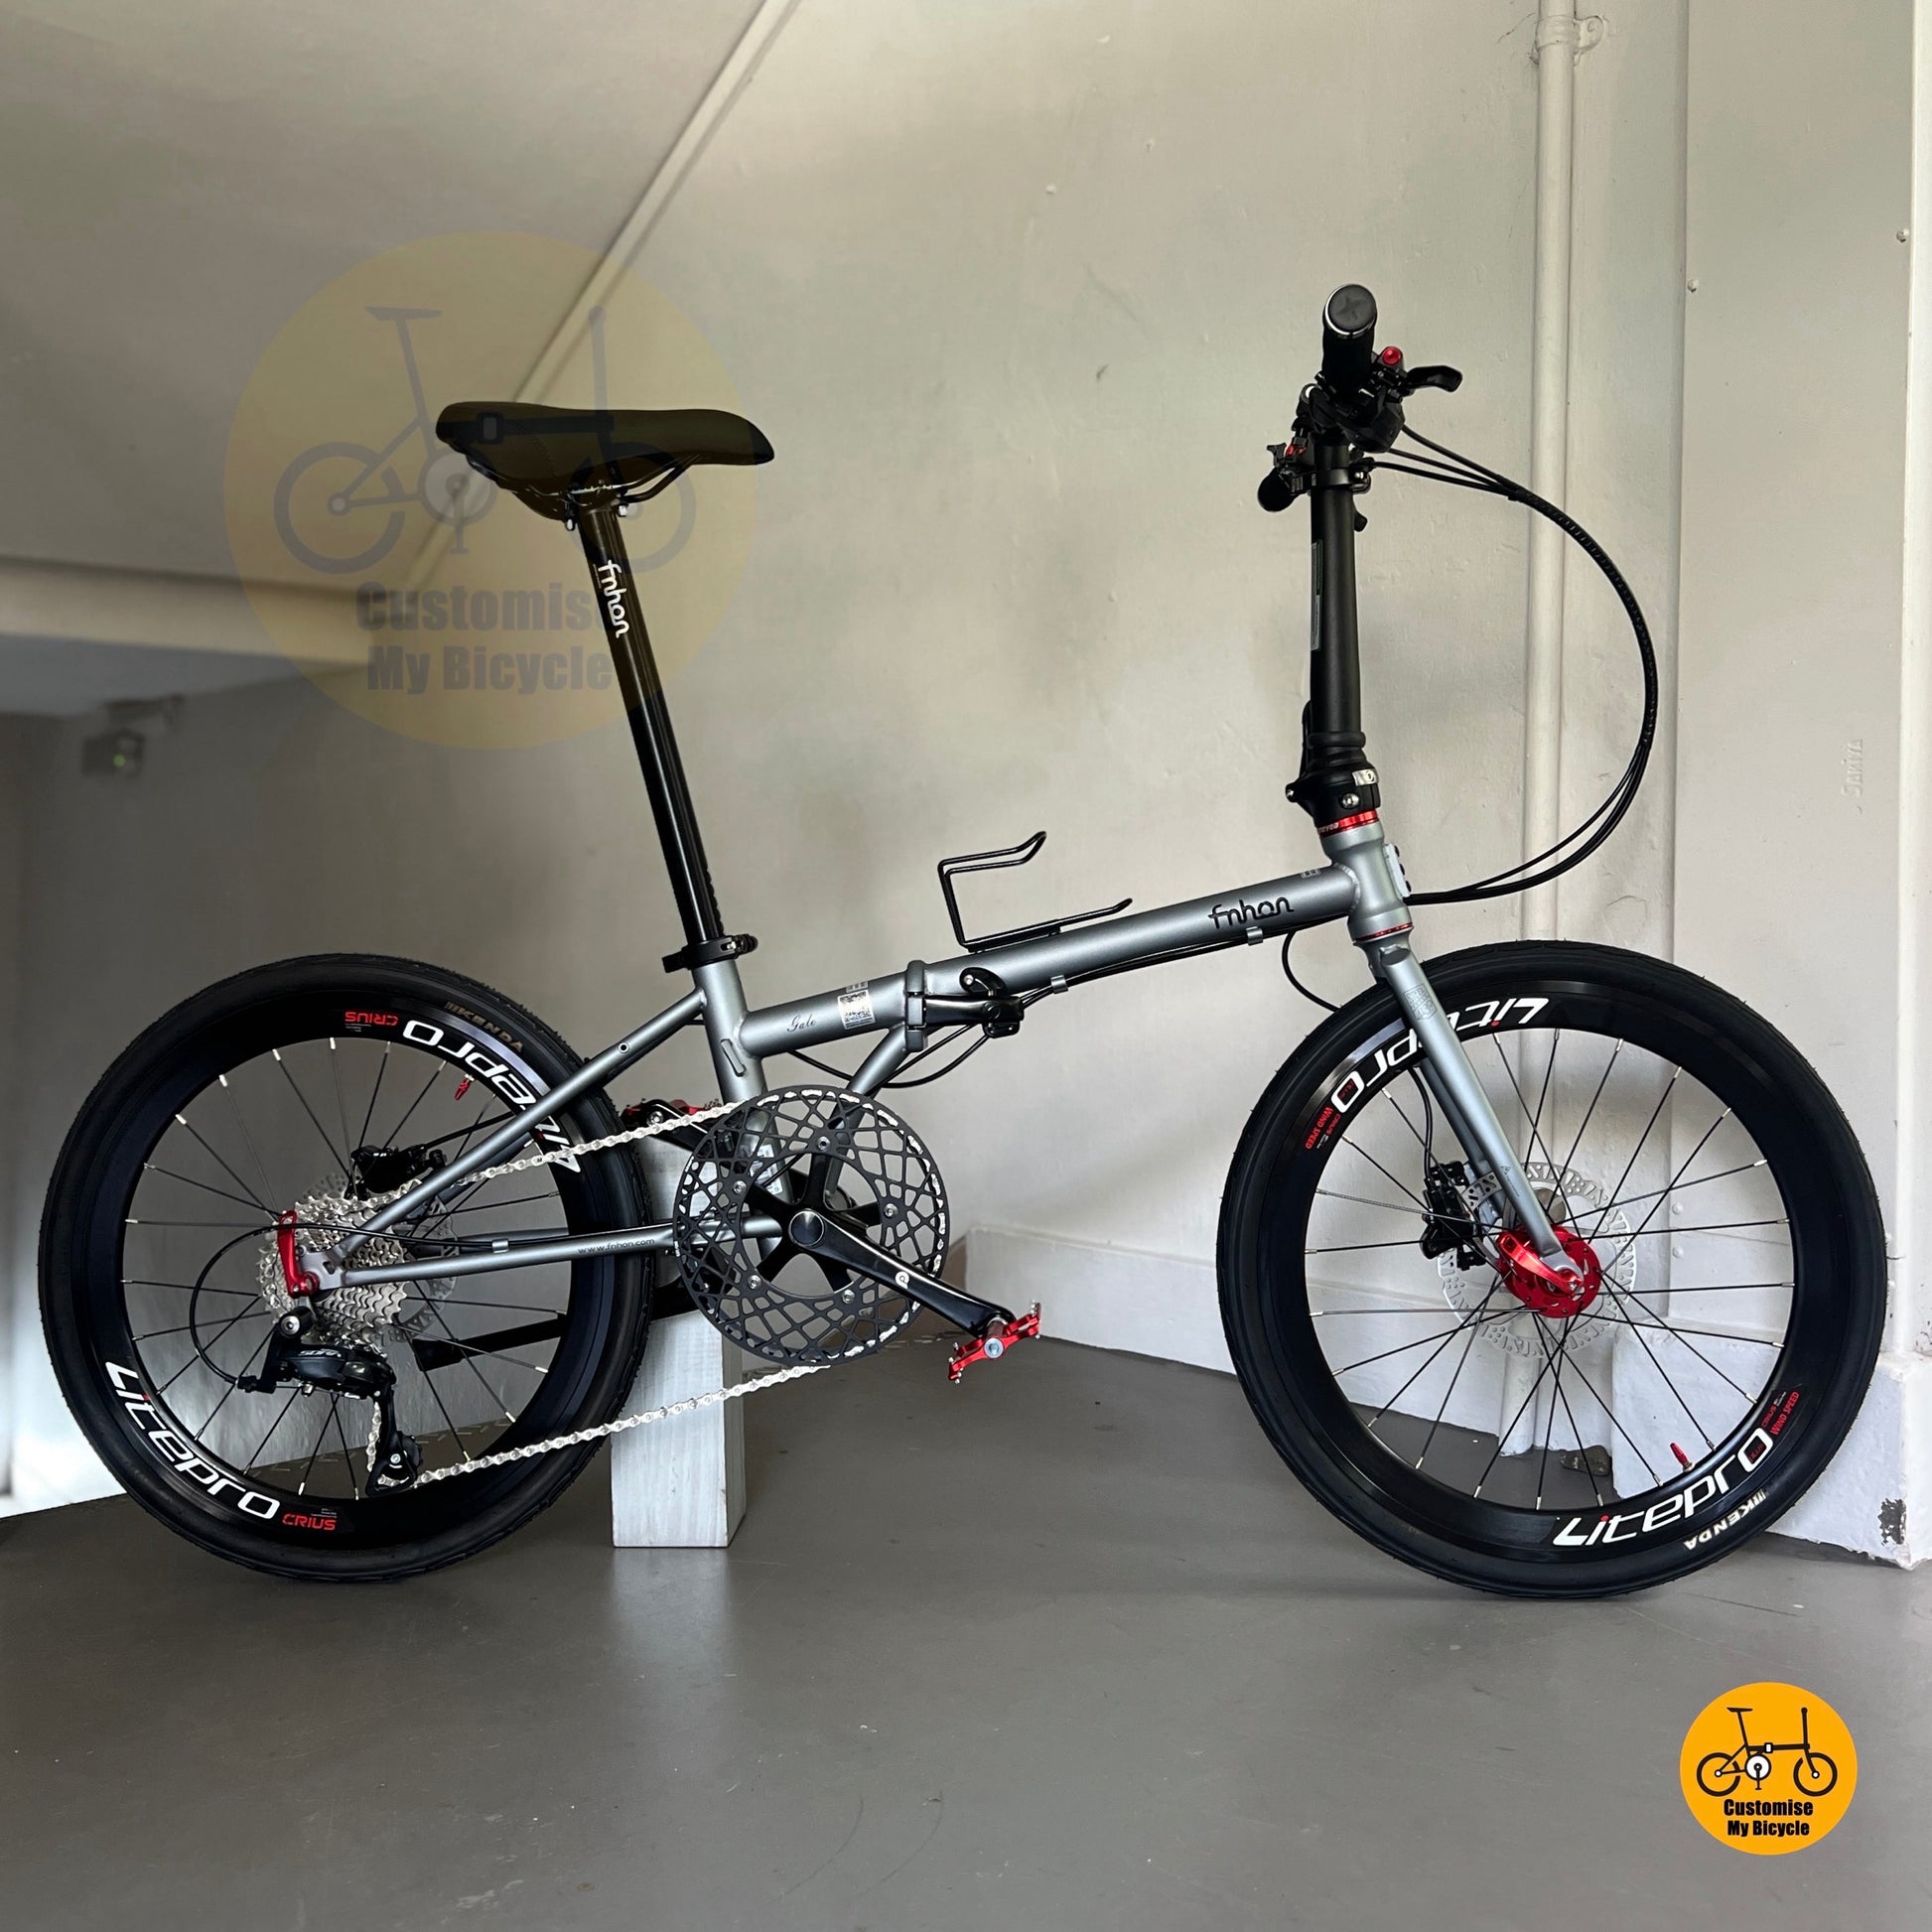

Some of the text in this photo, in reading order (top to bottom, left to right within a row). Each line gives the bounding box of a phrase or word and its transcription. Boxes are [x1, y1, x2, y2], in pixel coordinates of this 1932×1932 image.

[1207, 897, 1295, 929] fnhon
[345, 1011, 398, 1026] CRIUS
[458, 1007, 524, 1053] KENDA
[578, 1238, 655, 1254] www.fnhon.com
[282, 1513, 338, 1531] CRIUS
[1684, 1503, 1754, 1551] KENDA
